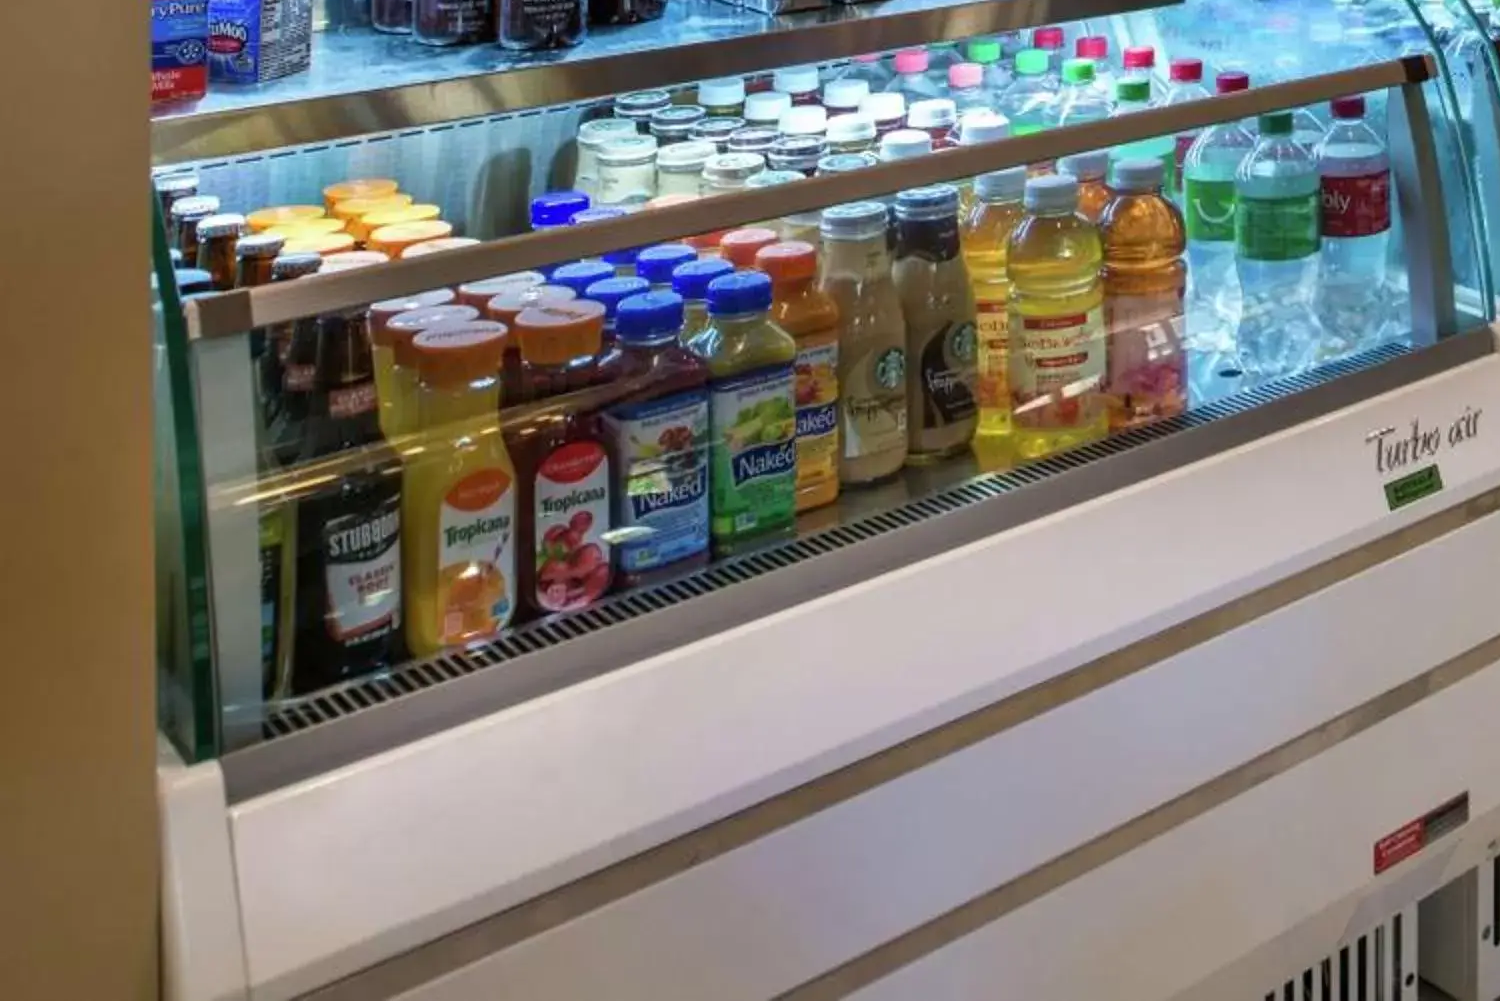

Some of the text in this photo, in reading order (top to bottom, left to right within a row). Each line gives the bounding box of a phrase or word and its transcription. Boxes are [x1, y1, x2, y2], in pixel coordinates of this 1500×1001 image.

[1365, 405, 1483, 473] Turbo air
[540, 485, 607, 515] Tropicana
[444, 513, 511, 548] Tropicana
